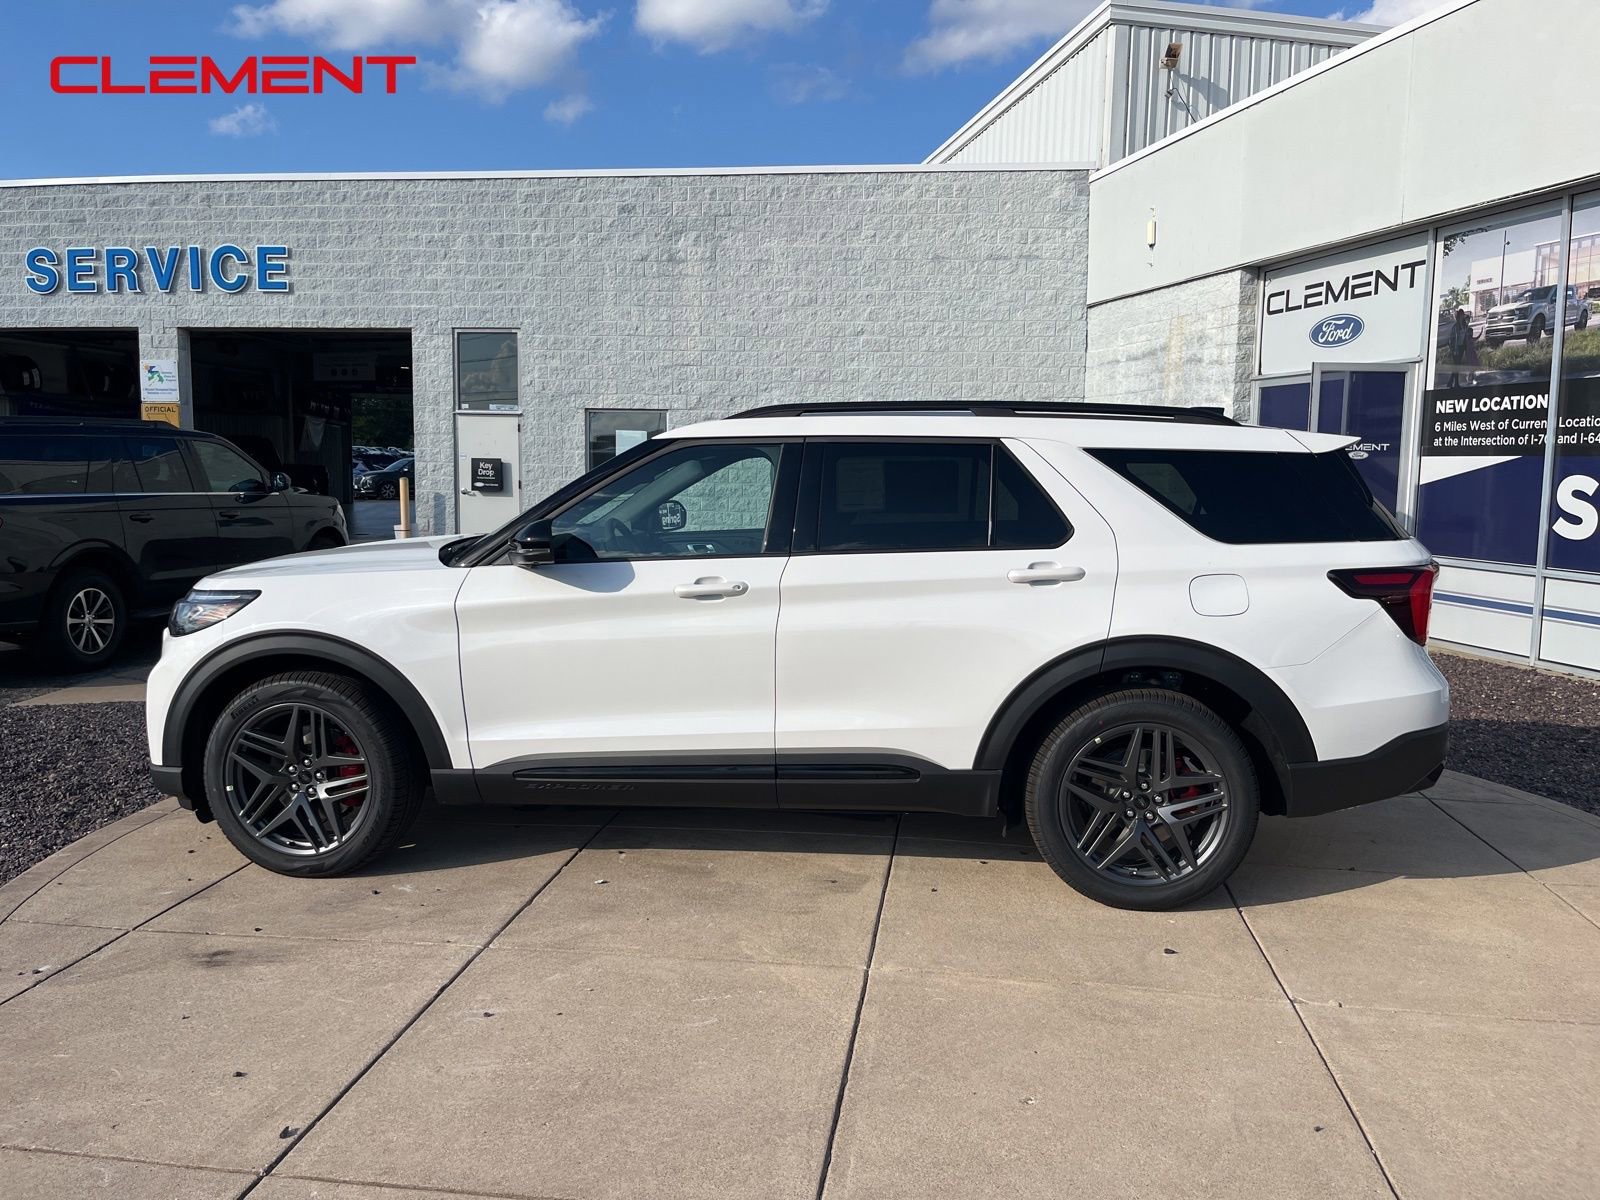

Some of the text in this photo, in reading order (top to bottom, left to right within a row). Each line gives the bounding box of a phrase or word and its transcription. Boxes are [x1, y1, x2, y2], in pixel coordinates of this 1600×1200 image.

[25, 243, 290, 294] SERVICE
[1266, 259, 1427, 316] CLEMENT
[1318, 318, 1354, 343] Ford
[1435, 393, 1549, 414] NEW LOCATION
[1434, 415, 1600, 432] 6 Miles West of Curren Locatio
[1433, 436, 1442, 447] at
[1444, 435, 1459, 446] the
[1460, 434, 1515, 446] Intersection
[1517, 433, 1529, 445] of
[1557, 432, 1578, 444] and
[1580, 432, 1600, 444] I-64
[477, 468, 495, 477] Drop
[479, 461, 493, 470] Key
